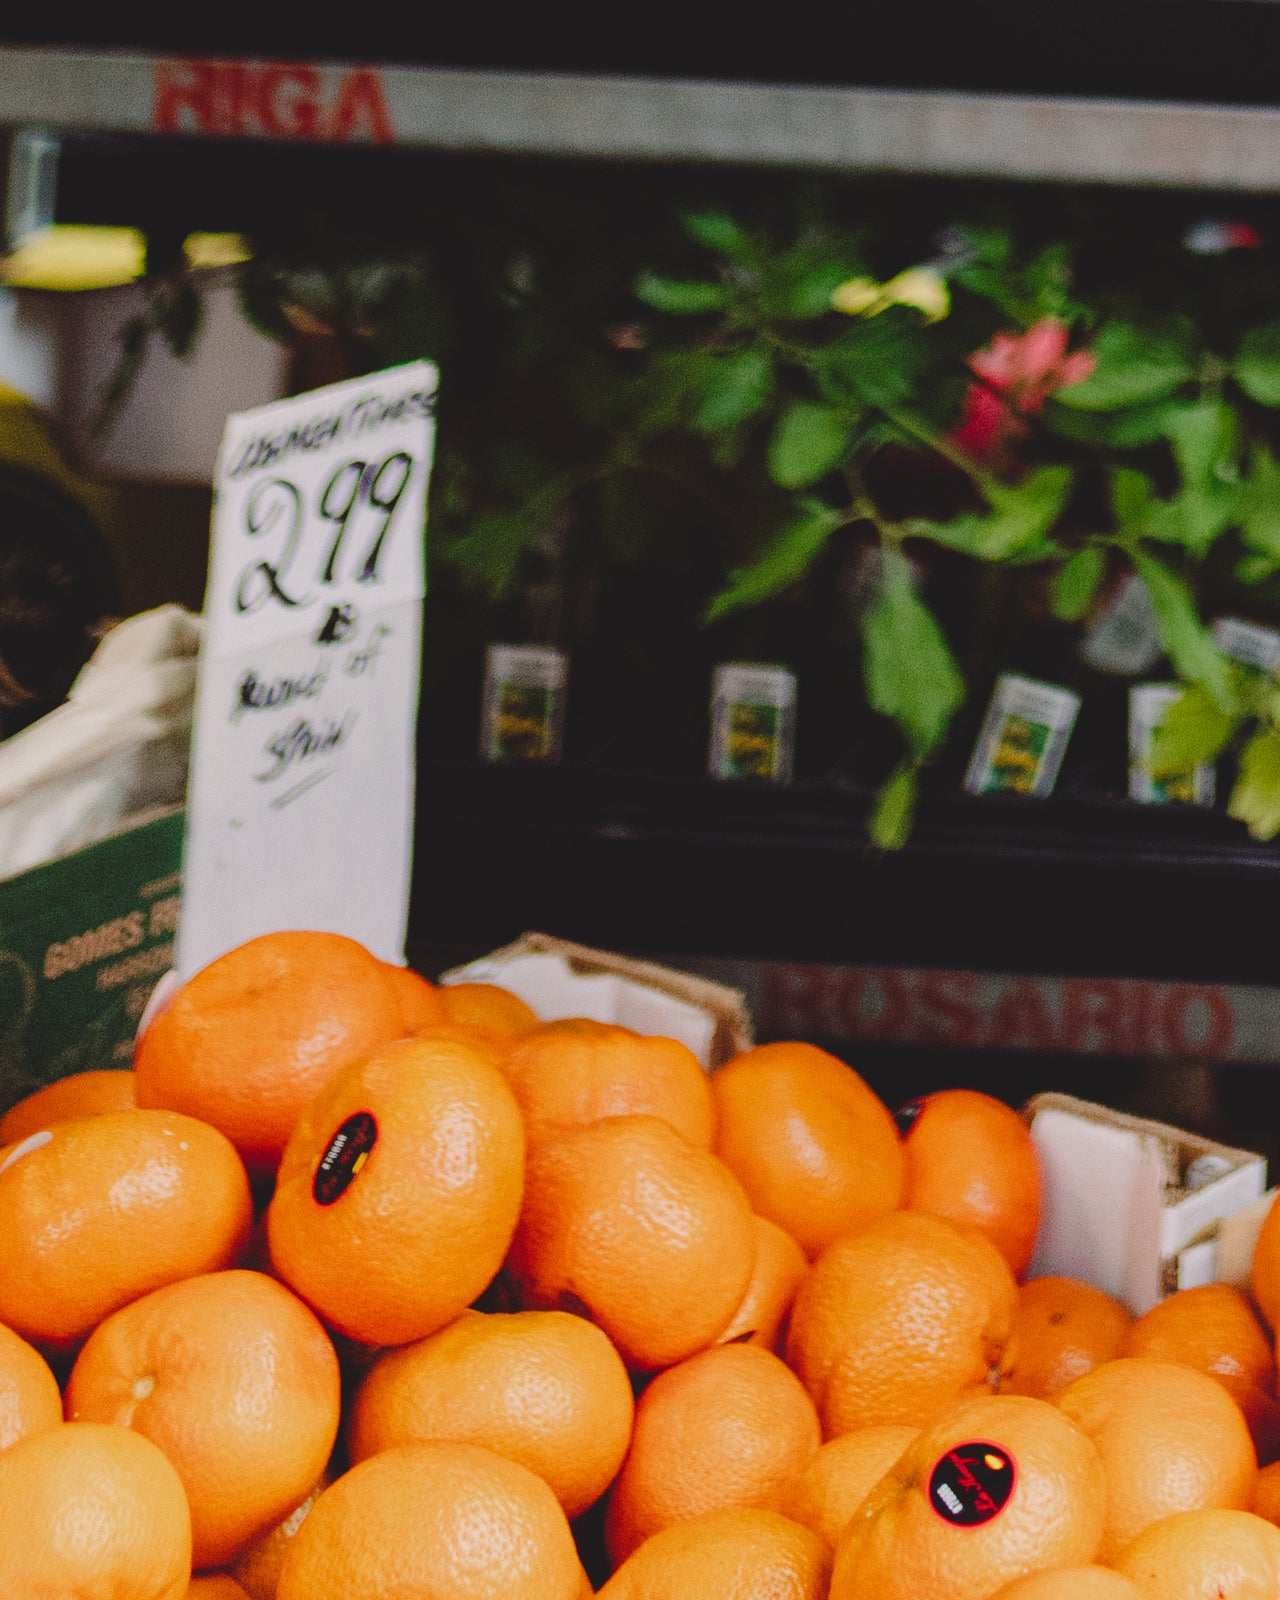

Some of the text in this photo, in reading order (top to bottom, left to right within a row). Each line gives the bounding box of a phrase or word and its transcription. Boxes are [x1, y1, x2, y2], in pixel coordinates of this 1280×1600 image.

[151, 55, 398, 147] RIGA
[234, 450, 413, 616] 299
[757, 960, 1237, 1060] ROSARIO
